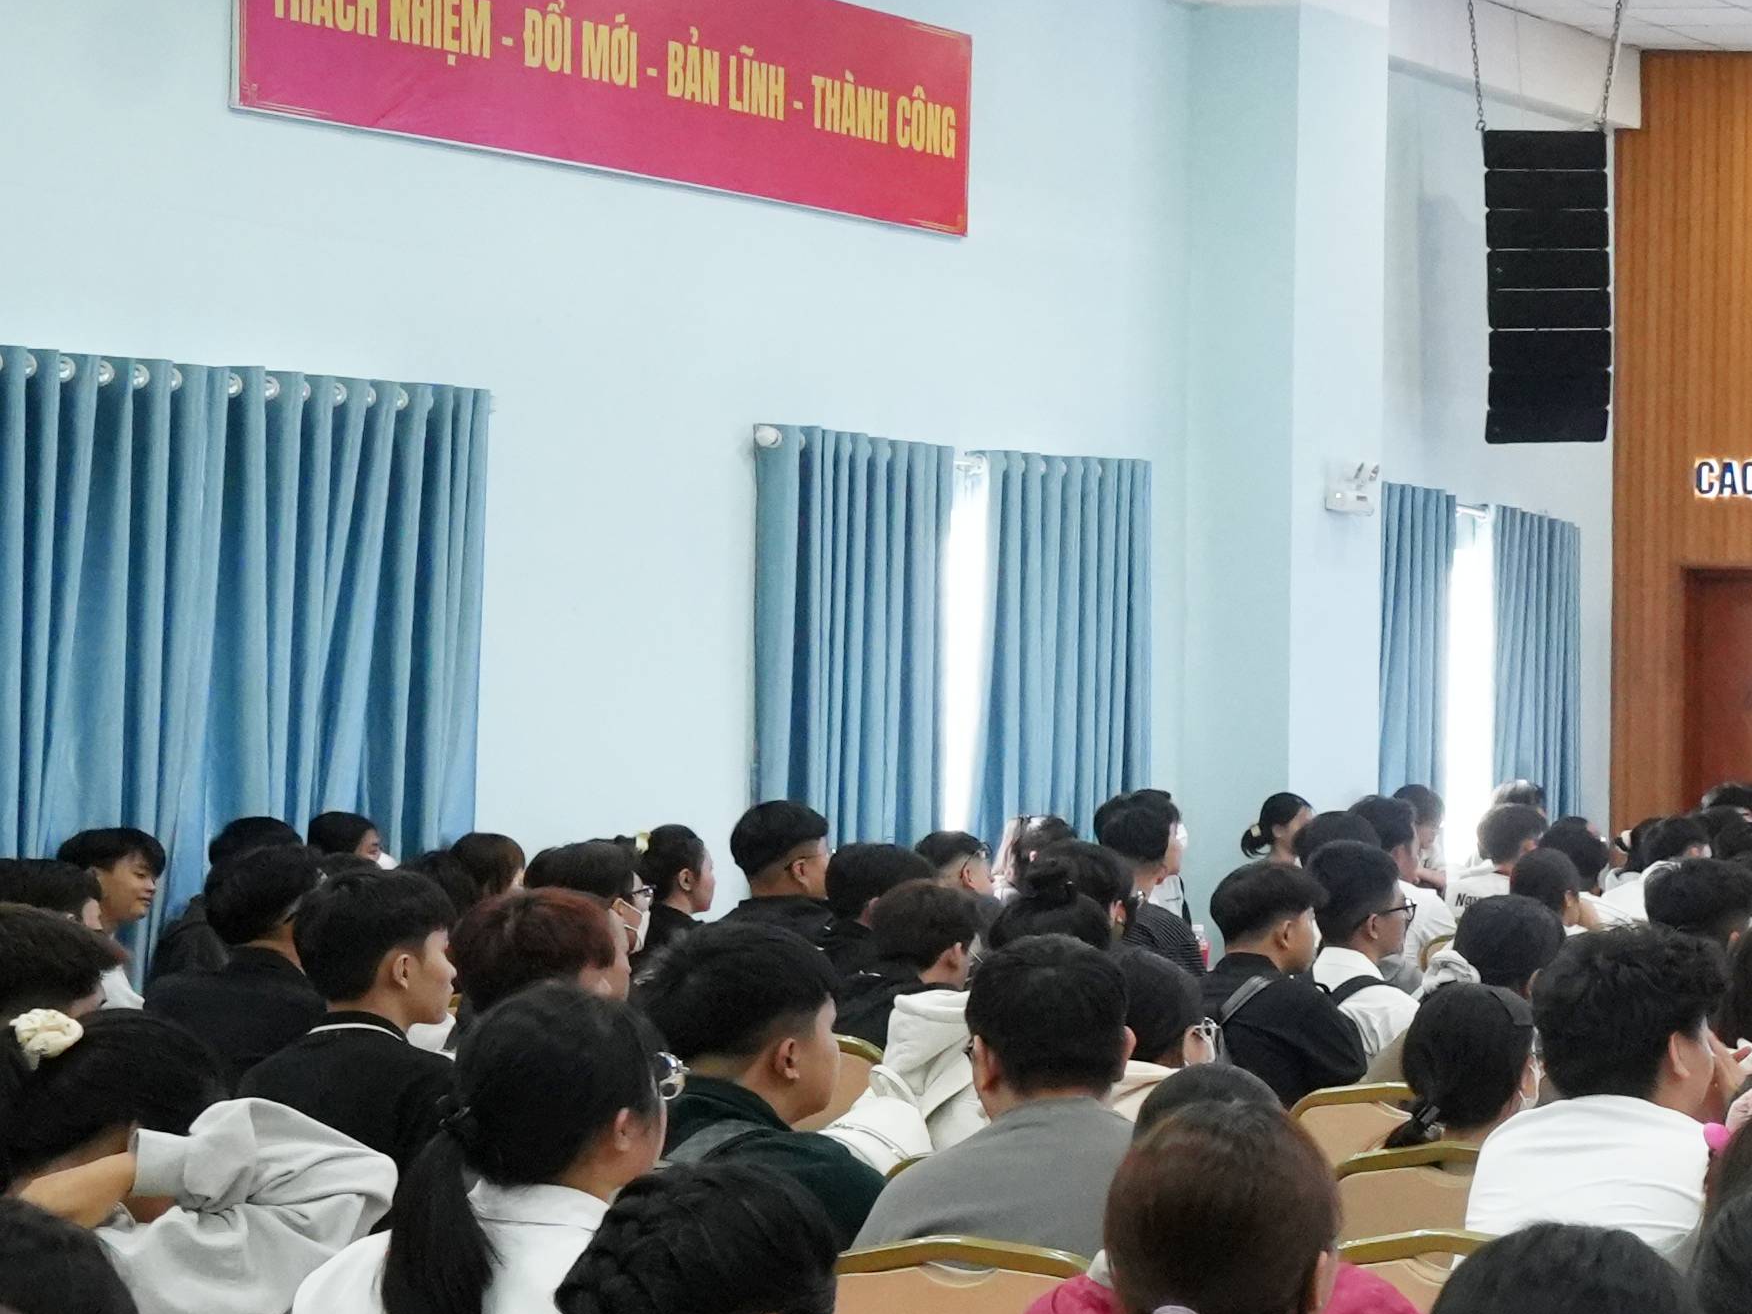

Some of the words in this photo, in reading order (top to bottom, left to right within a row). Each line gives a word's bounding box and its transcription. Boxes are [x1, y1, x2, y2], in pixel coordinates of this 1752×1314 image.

[581, 14, 638, 89] MỚI
[667, 25, 720, 104] BẢN
[729, 46, 786, 121] LĨNH
[811, 71, 889, 143] THÀNH
[895, 86, 957, 159] CÔNG
